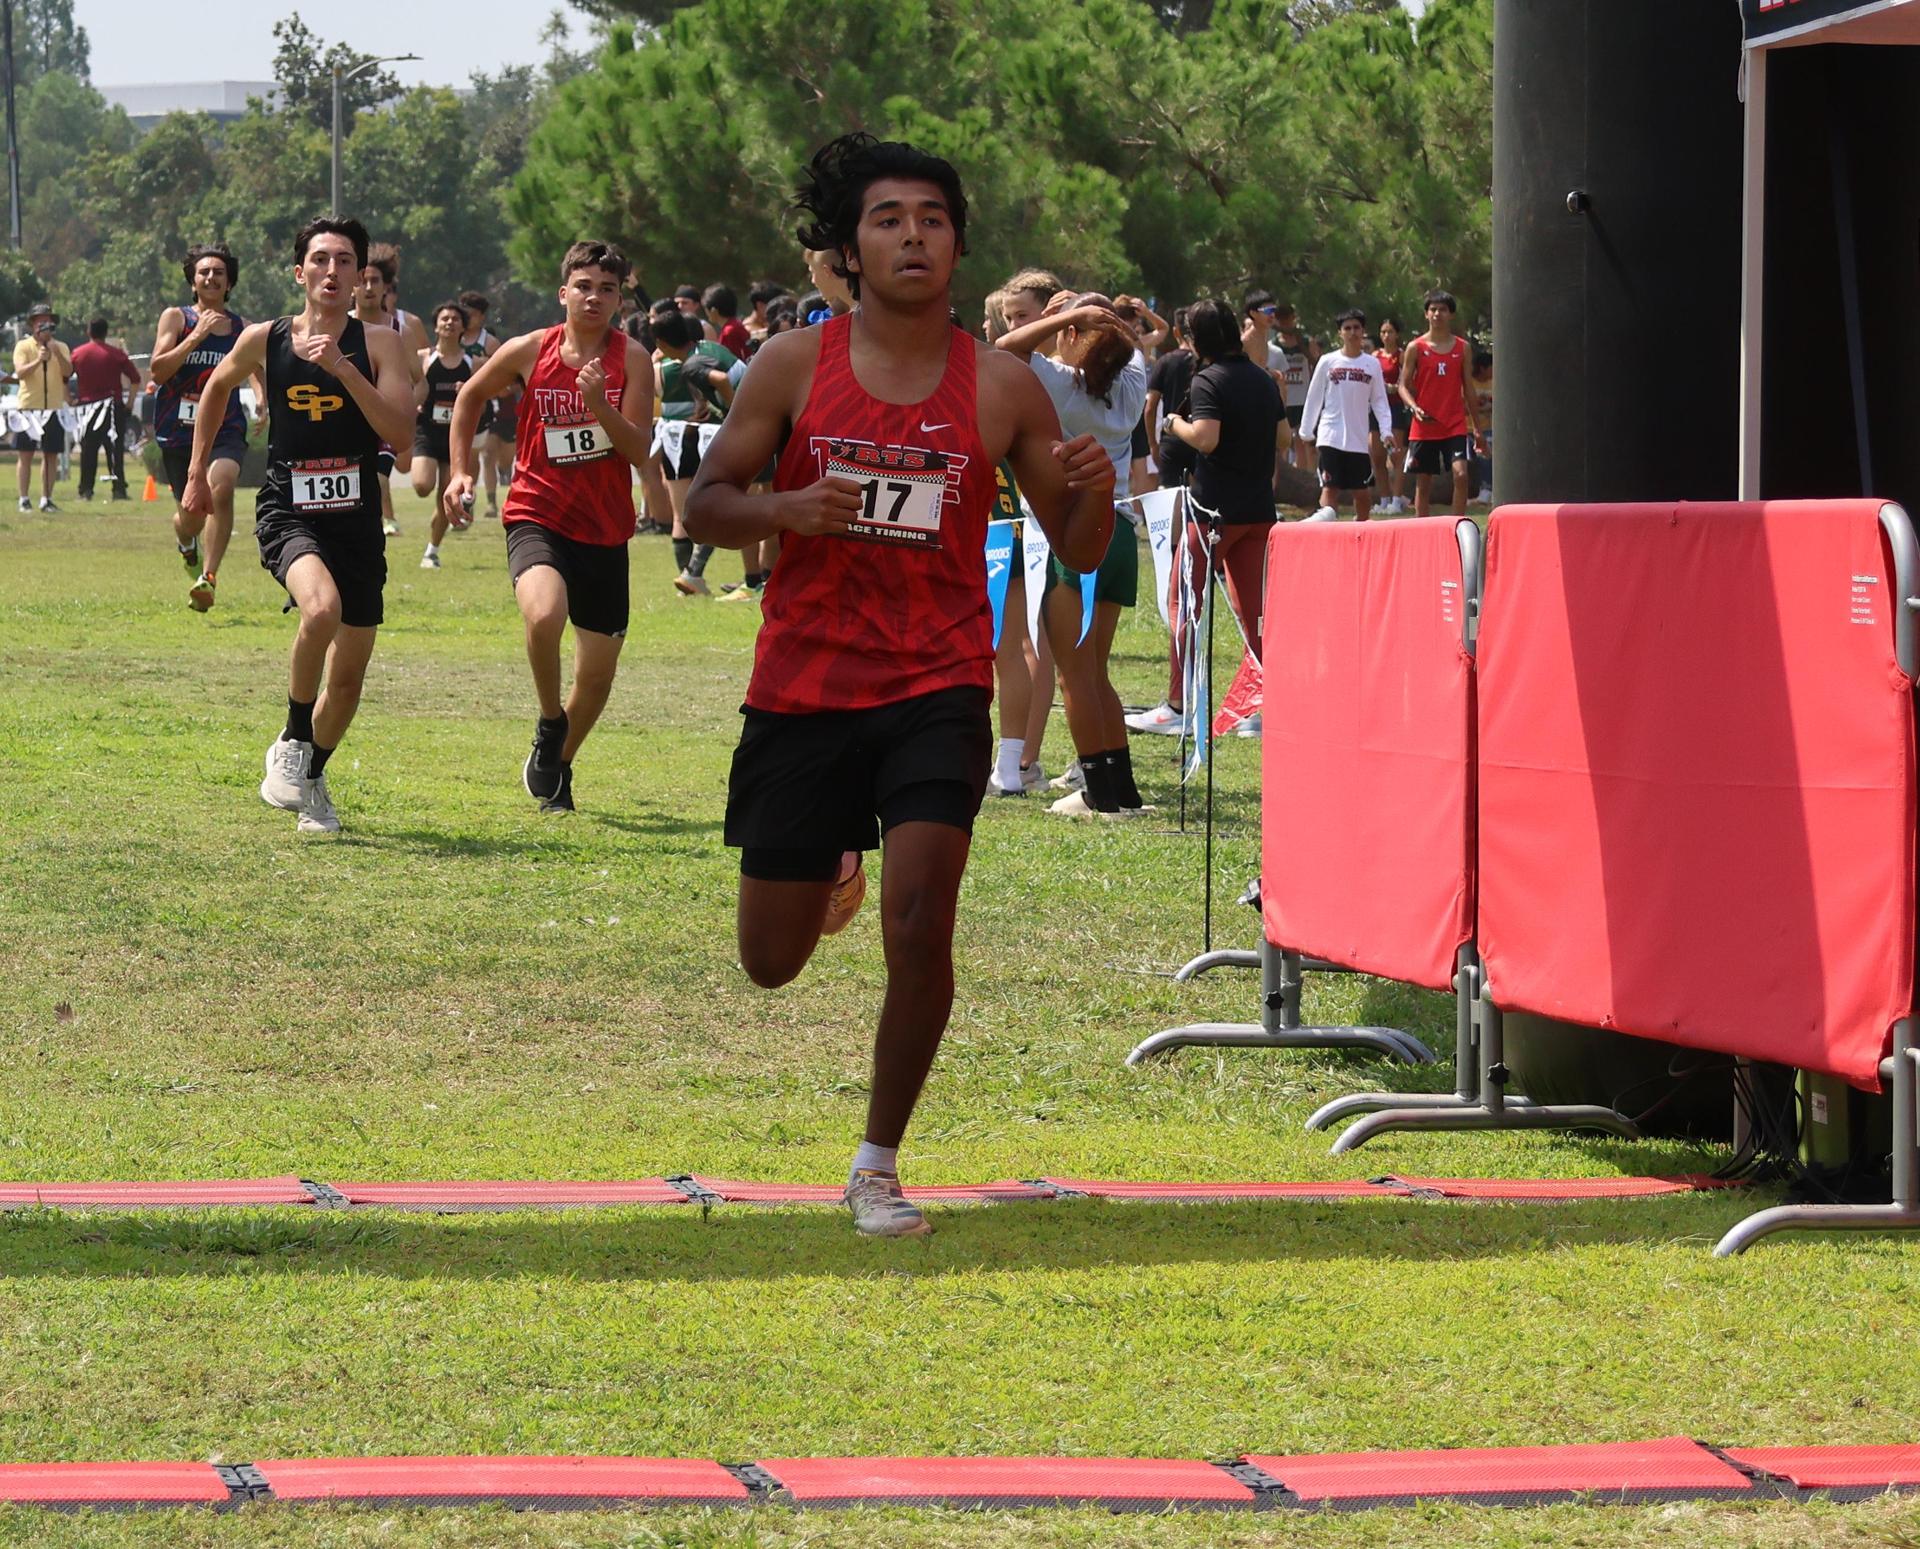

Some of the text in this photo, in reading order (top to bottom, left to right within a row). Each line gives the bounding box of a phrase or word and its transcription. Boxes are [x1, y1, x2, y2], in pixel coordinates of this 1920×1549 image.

[1437, 362, 1446, 376] K
[286, 384, 344, 422] SP
[534, 388, 622, 417] TRIE
[564, 429, 596, 454] 18
[556, 450, 609, 464] RACE TIMING
[855, 446, 926, 468] RTS
[304, 475, 351, 501] 130
[301, 500, 355, 511] RACE TIMING
[861, 478, 913, 523] 17
[874, 526, 927, 541] TIMING
[1150, 518, 1170, 534] BROOKS
